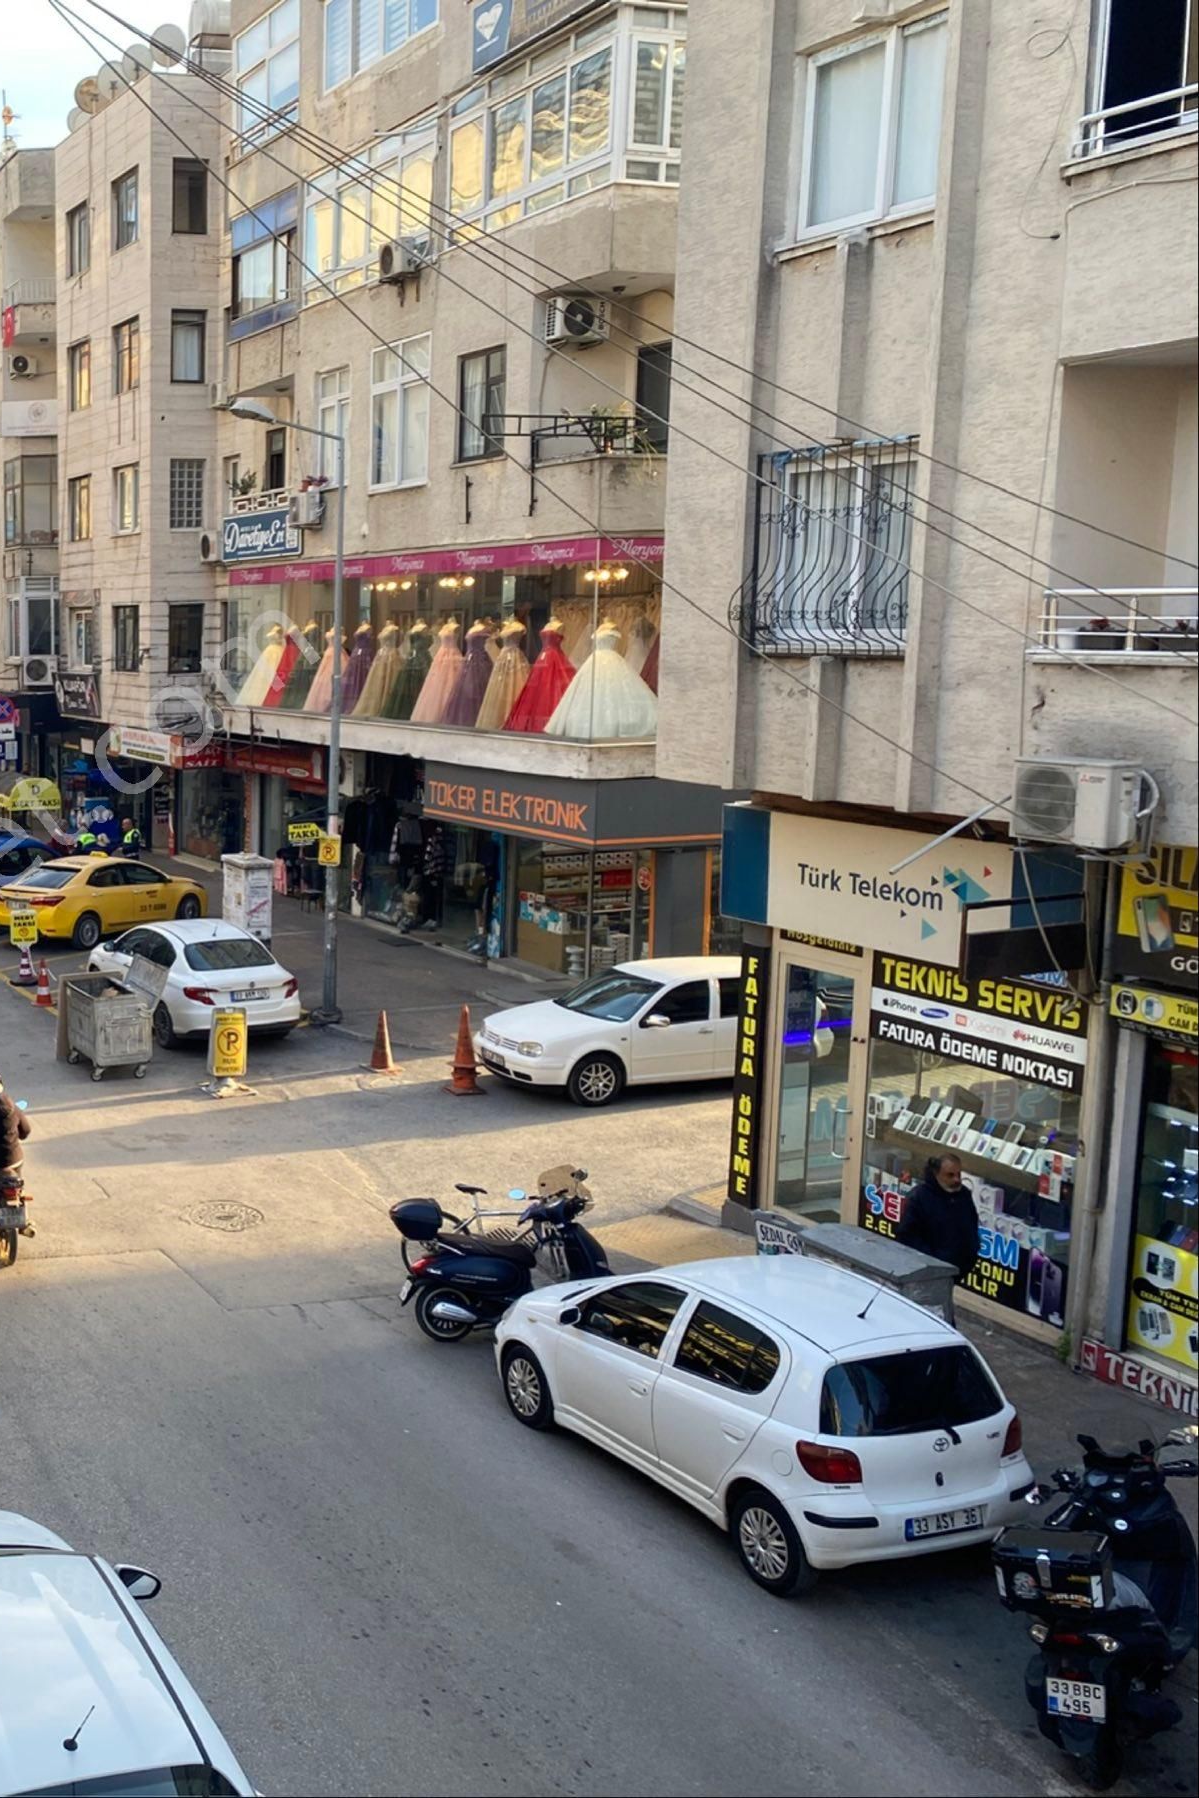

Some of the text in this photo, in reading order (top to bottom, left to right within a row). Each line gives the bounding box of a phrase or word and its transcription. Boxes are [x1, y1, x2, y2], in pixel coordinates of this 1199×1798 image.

[428, 780, 477, 812] TOKER
[797, 862, 944, 912] Türk Telekom
[889, 998, 918, 1015] iPhone
[1026, 1033, 1075, 1053] HUAWEI
[879, 1020, 1074, 1088] FATURA ÖDEME NOKTASI
[733, 956, 759, 1195] FATURA ÖDEME
[759, 1224, 785, 1244] SEDAL
[865, 1213, 896, 1239] 2.EL
[913, 1518, 930, 1534] 33
[936, 1513, 956, 1531] ASY
[1051, 1680, 1102, 1700] 33 BBC
[1062, 1700, 1092, 1714] 495
